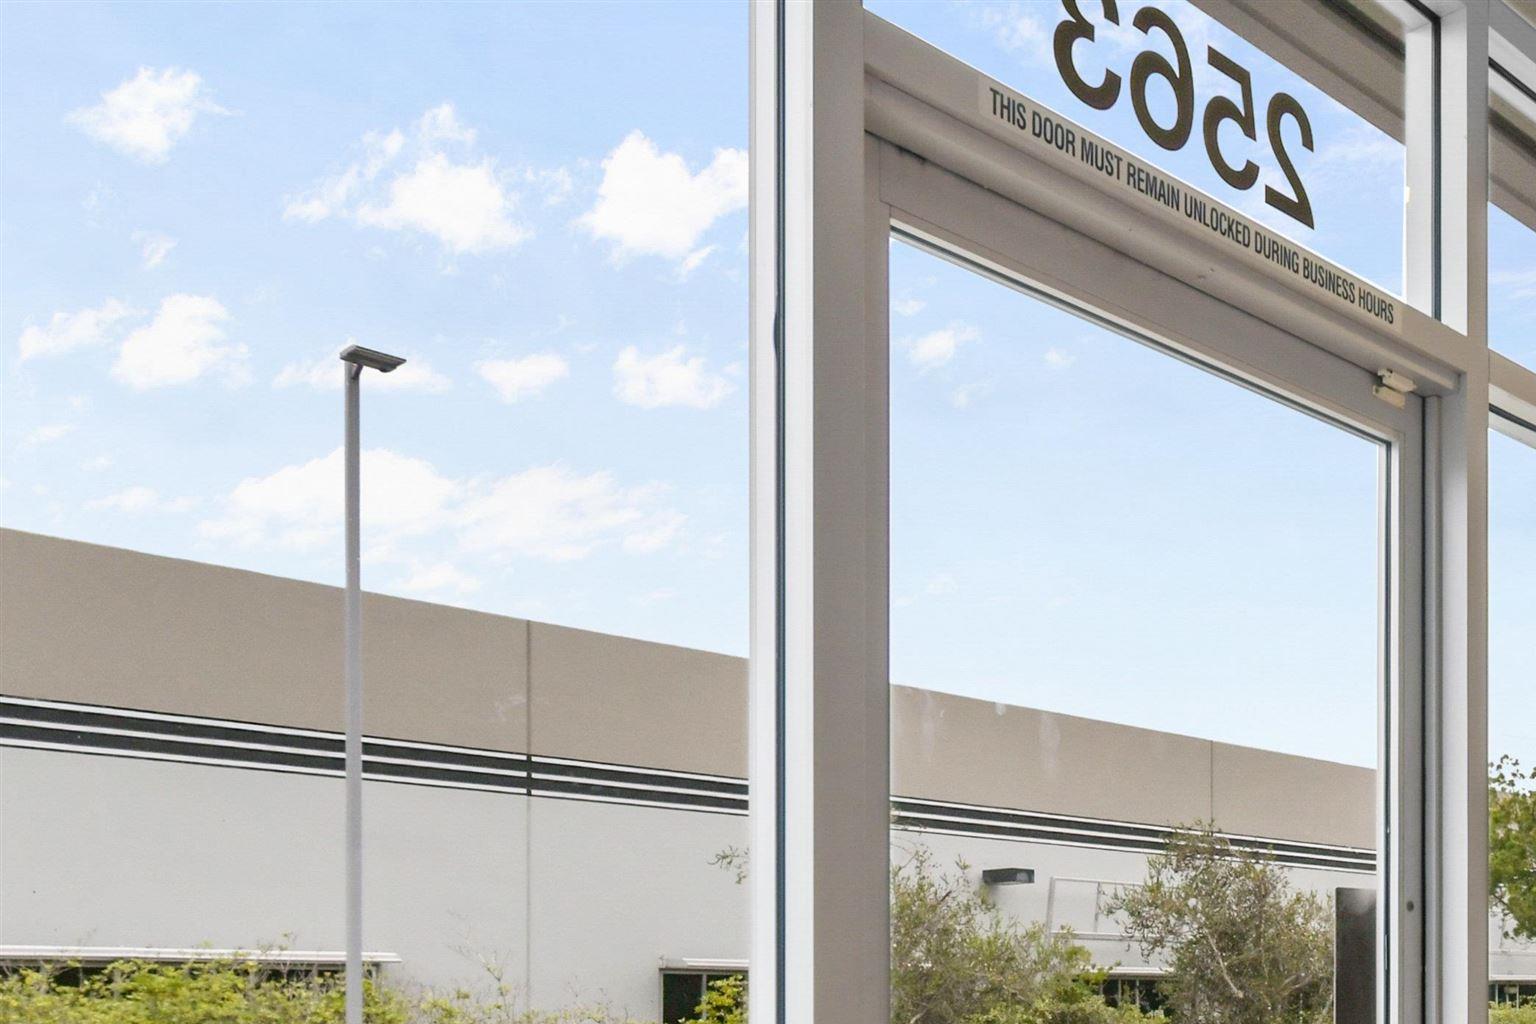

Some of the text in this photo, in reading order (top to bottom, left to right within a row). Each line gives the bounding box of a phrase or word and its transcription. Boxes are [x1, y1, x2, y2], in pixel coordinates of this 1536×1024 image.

[989, 87, 1394, 324] THIS DOOR MUST REMAIN UNLOCKED DURING BUSINESS HOURS
